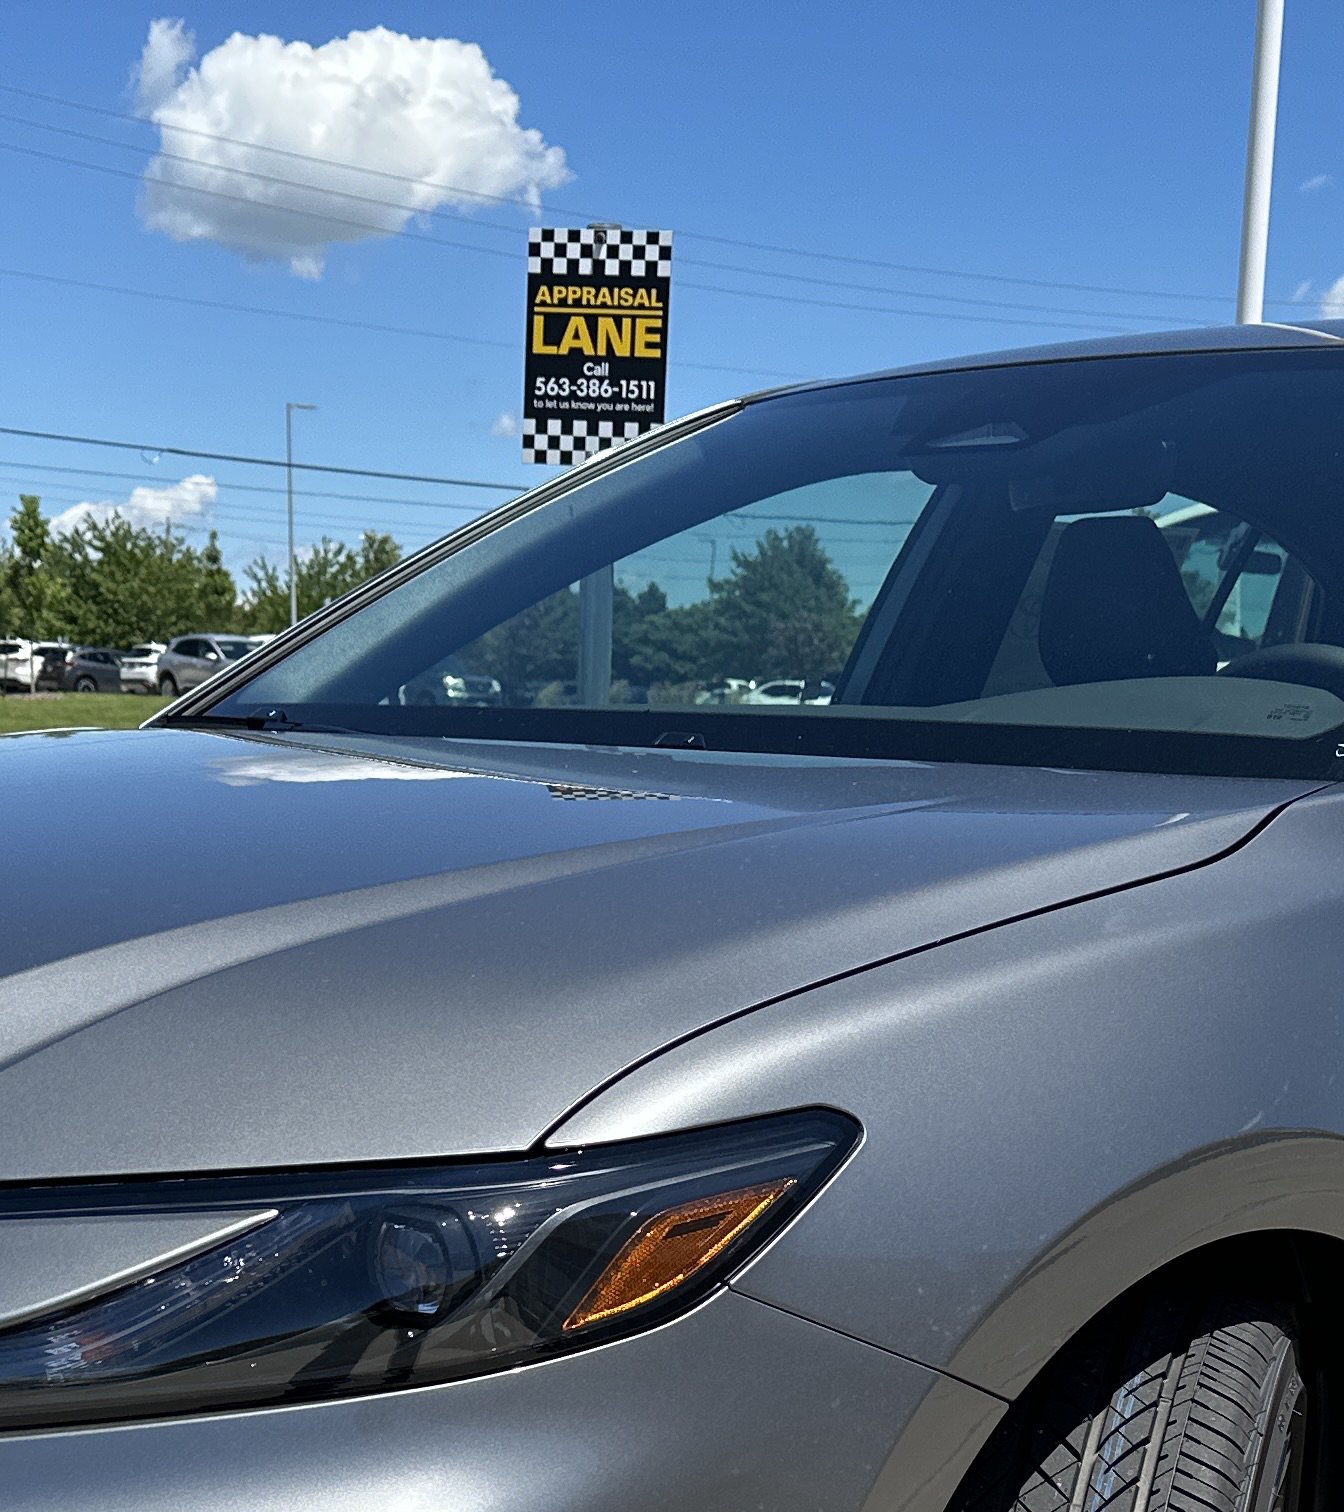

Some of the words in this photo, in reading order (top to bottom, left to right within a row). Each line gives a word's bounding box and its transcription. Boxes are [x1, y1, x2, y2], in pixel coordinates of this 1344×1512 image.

[535, 285, 664, 307] APPRAISAL
[532, 314, 663, 358] LANE
[582, 362, 610, 377] Call
[534, 376, 656, 400] 563-386-1511
[533, 399, 544, 409] to
[545, 399, 558, 409] let
[559, 401, 570, 410] us
[571, 399, 595, 410] know
[597, 401, 614, 412] you
[615, 402, 630, 411] are
[631, 401, 655, 413] here!
